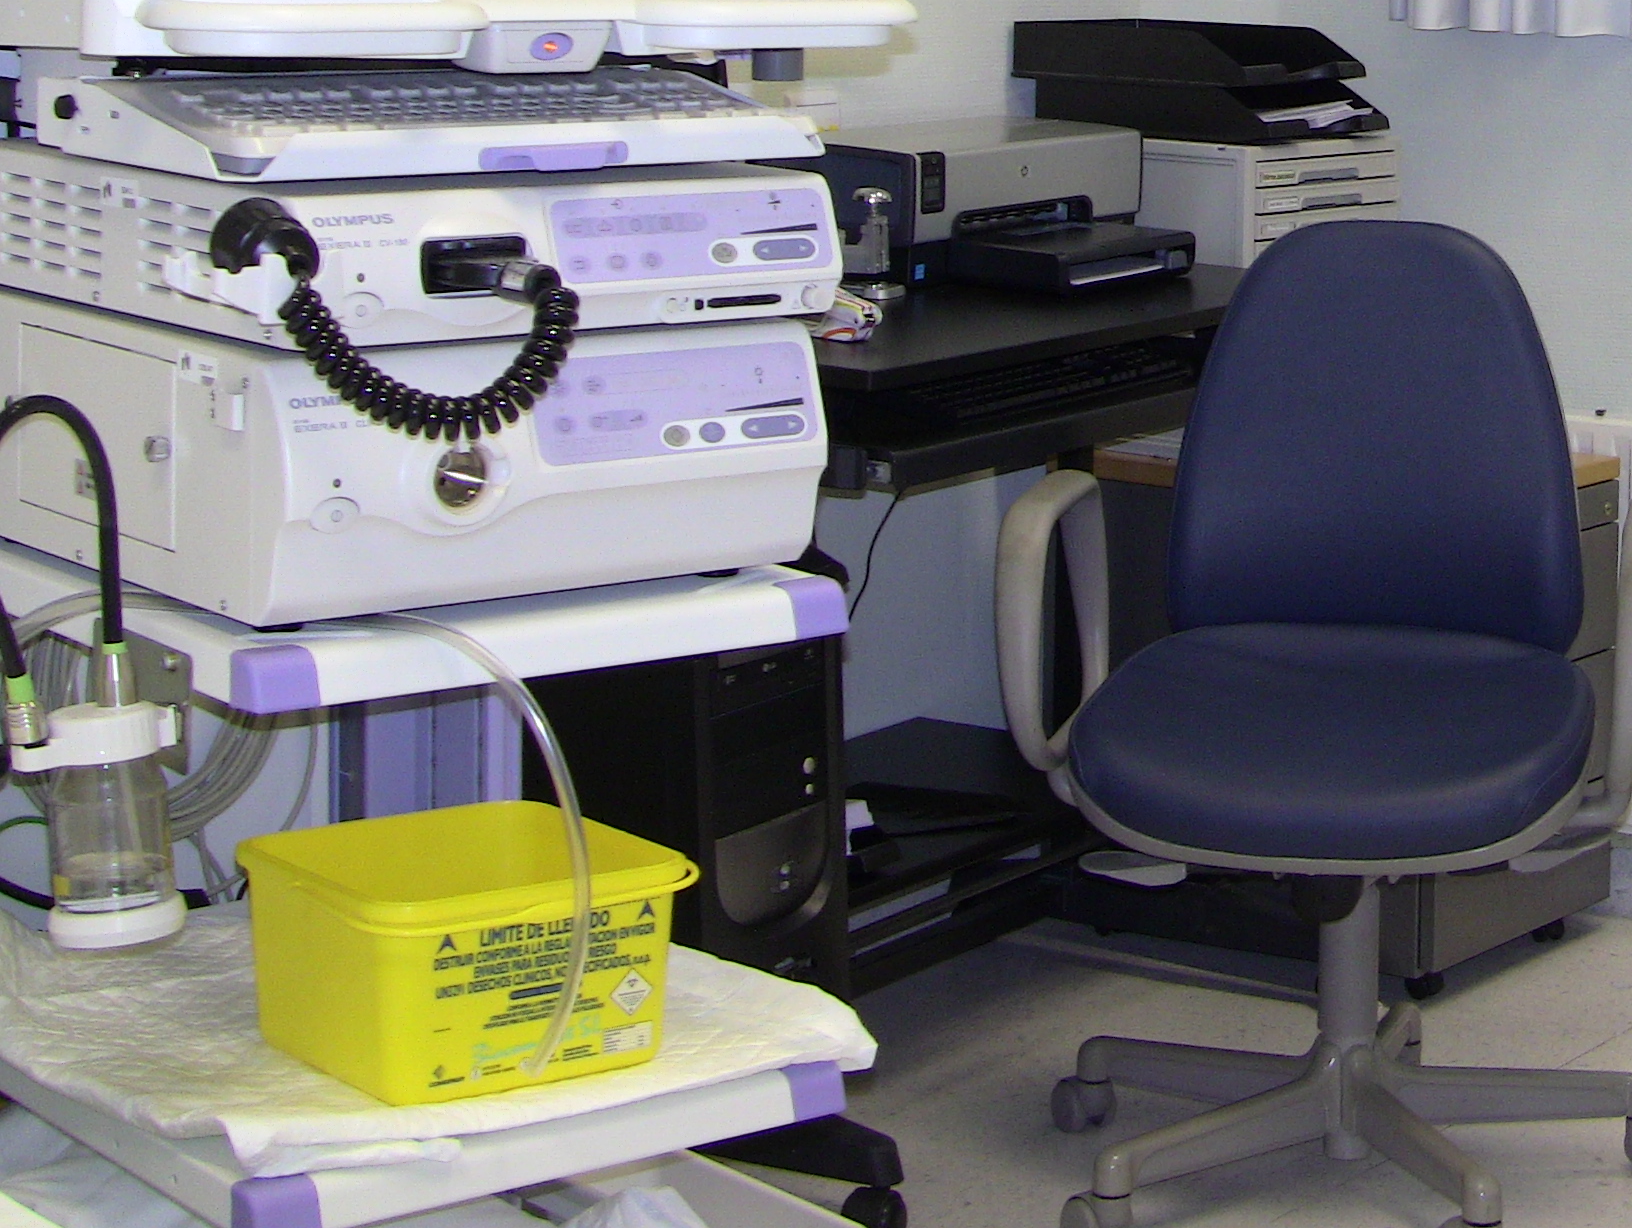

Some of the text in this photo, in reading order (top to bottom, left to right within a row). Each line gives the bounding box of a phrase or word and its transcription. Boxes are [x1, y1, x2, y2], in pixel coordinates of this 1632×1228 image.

[311, 212, 394, 228] OLYMPUS
[289, 394, 341, 409] OLYM
[479, 909, 611, 947] LIMITE DE LLEDO
[476, 946, 526, 964] CONFORME
[531, 941, 543, 954] LA
[467, 974, 512, 994] DESECHOS
